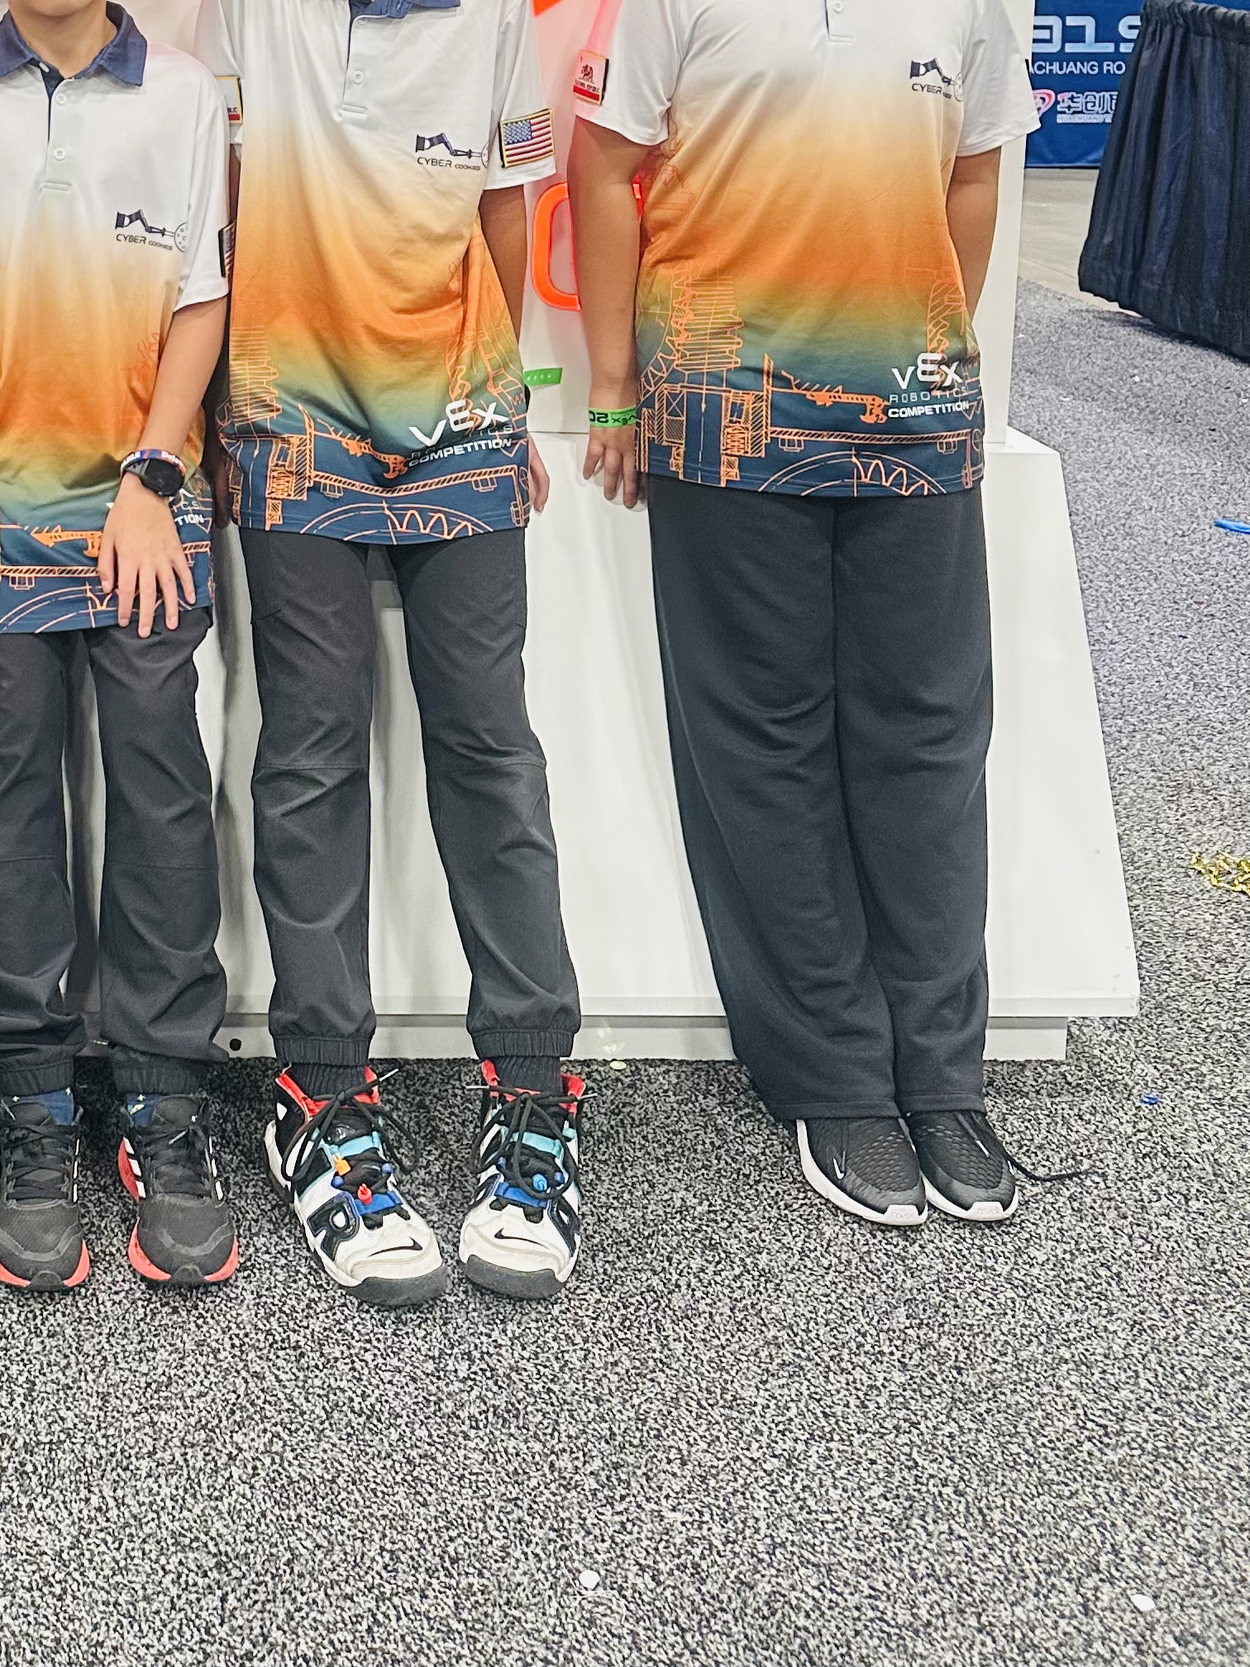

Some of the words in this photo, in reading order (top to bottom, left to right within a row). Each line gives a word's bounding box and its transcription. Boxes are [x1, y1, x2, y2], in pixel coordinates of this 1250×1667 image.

[911, 83, 943, 94] CYBER
[417, 157, 452, 168] CYBER
[116, 234, 147, 244] CYBER
[891, 352, 963, 390] VEX
[889, 386, 967, 403] ROBOTICS
[888, 400, 969, 418] COMPETITION
[408, 399, 509, 447] VEX
[408, 438, 512, 467] COMPETITION
